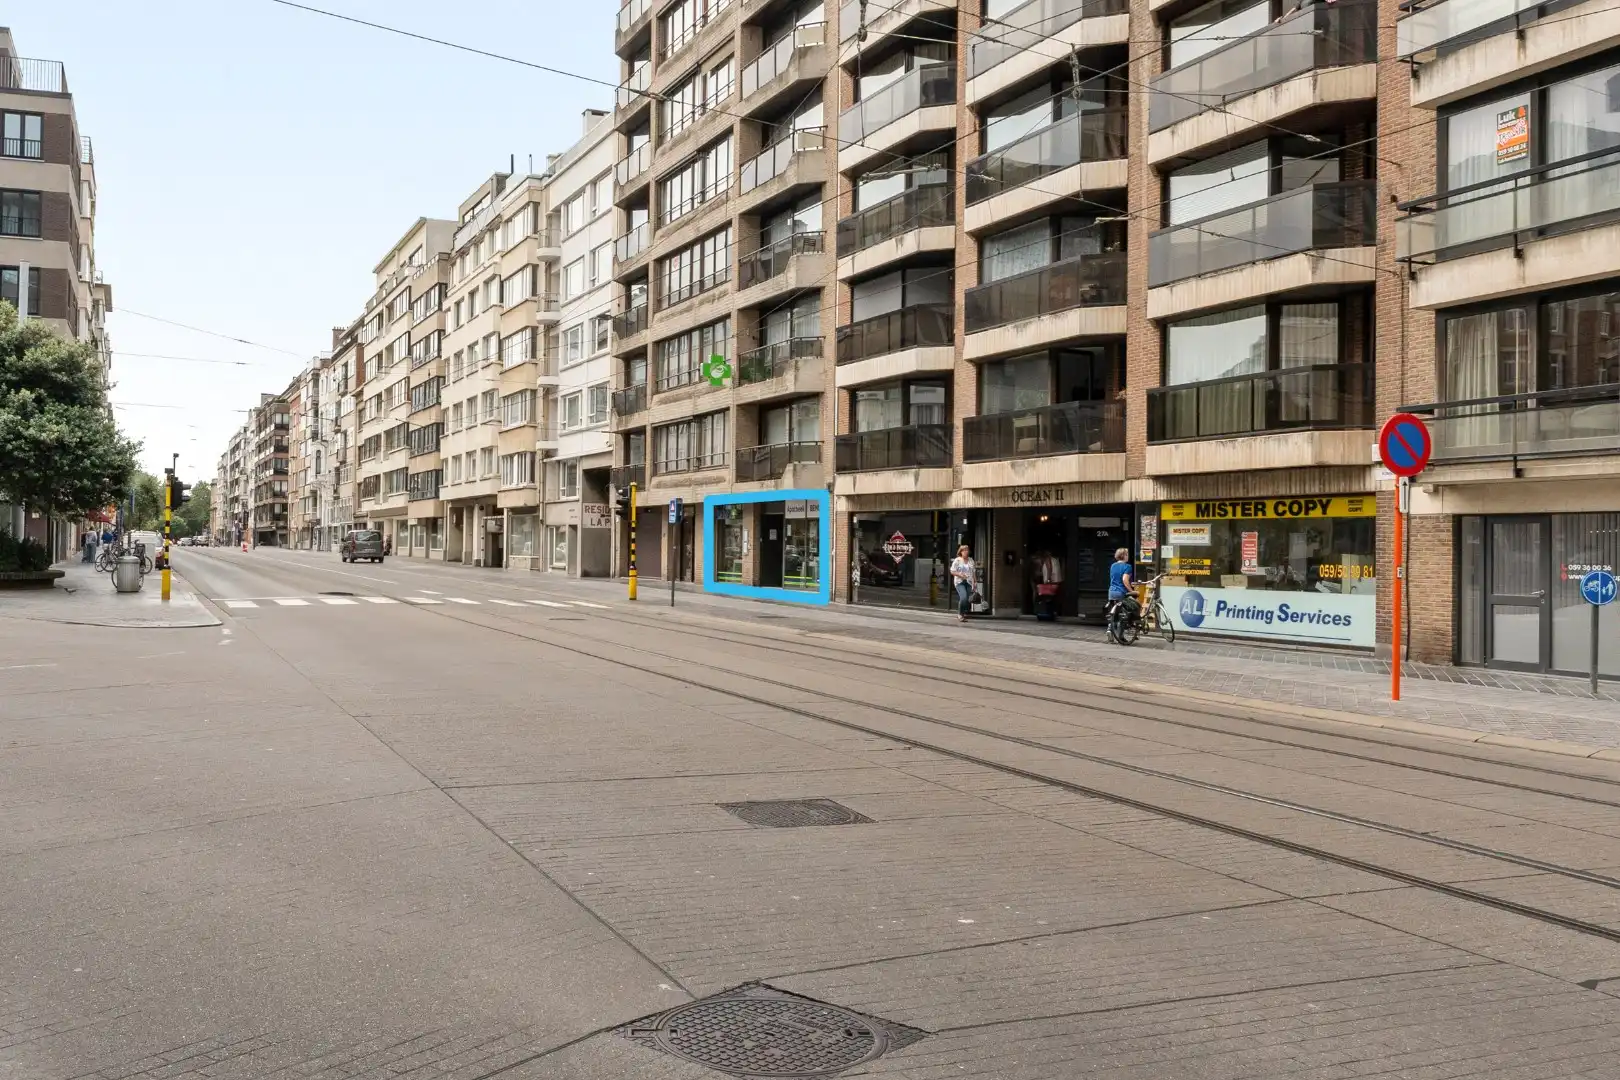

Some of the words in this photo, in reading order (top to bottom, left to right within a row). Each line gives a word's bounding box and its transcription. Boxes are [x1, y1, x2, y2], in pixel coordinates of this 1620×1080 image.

[1497, 110, 1515, 123] Luk
[1011, 490, 1052, 502] OCEAN
[1055, 489, 1064, 500] II
[1196, 501, 1267, 518] MISTER
[1273, 499, 1332, 516] COPY
[1363, 565, 1373, 578] 81
[1215, 600, 1274, 625] Printing
[1277, 603, 1352, 626] Services
